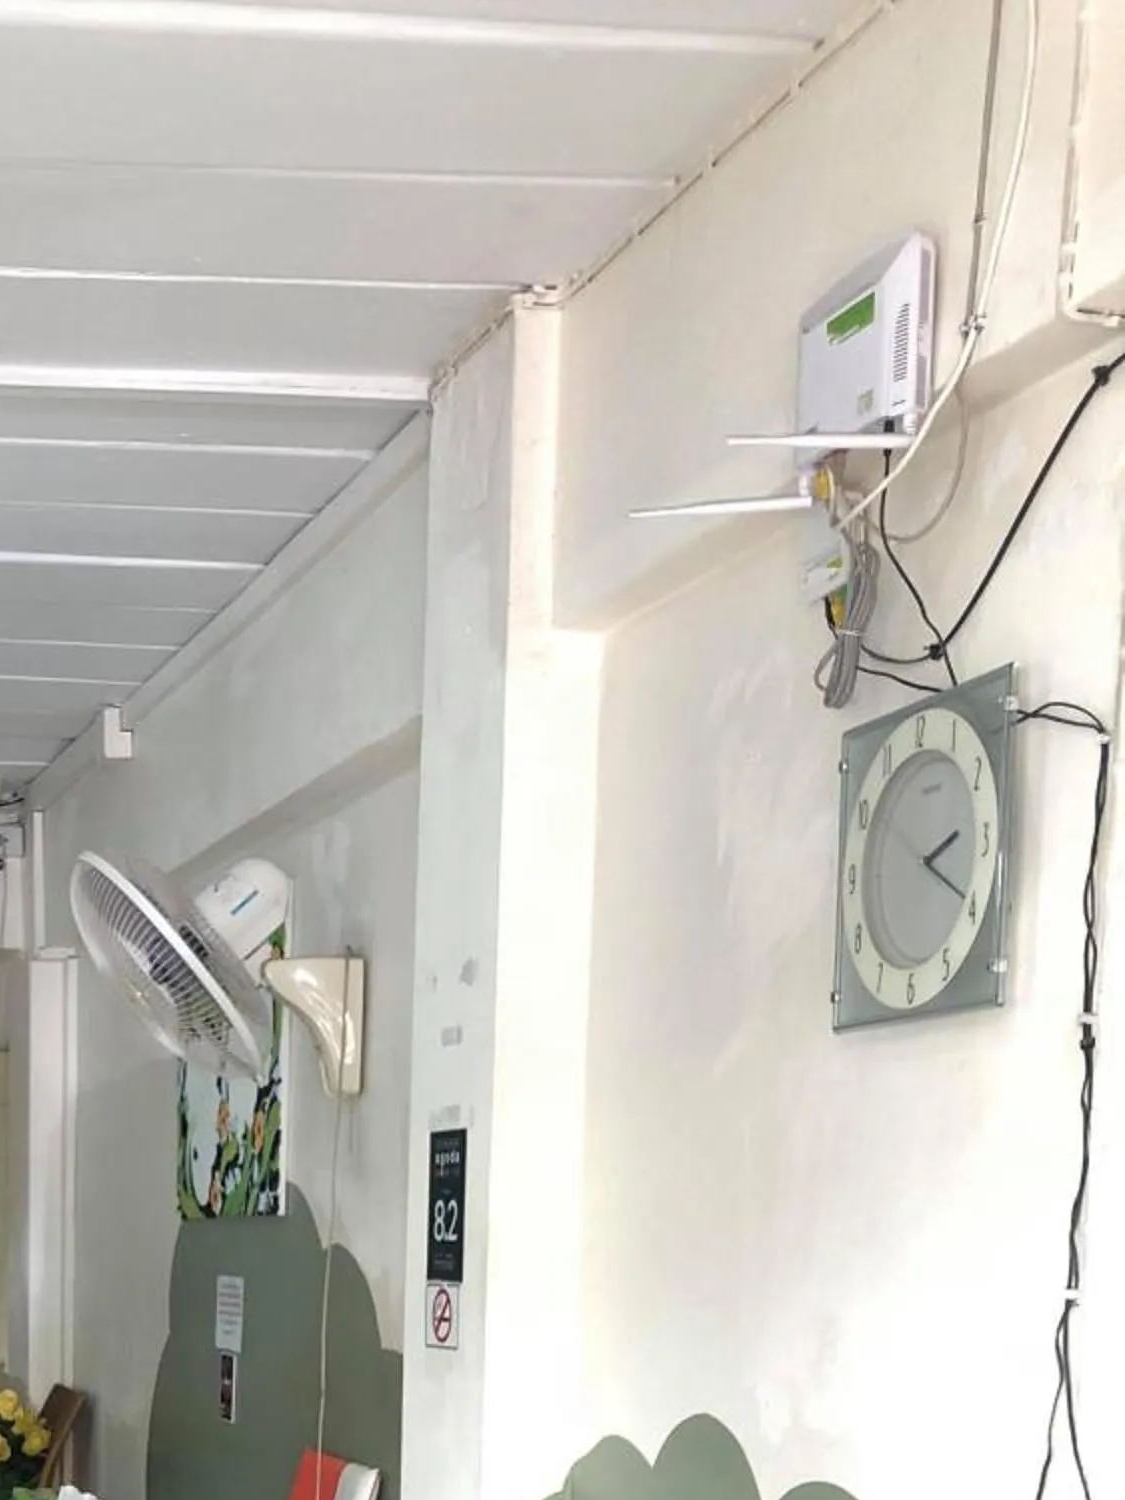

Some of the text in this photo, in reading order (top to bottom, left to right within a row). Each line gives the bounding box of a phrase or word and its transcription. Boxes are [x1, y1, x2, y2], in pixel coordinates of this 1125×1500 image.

[974, 756, 982, 791] 2
[848, 864, 856, 895] 9
[855, 923, 863, 954] 8
[876, 963, 884, 993] 7
[942, 947, 951, 982] 5
[907, 972, 916, 1005] 6
